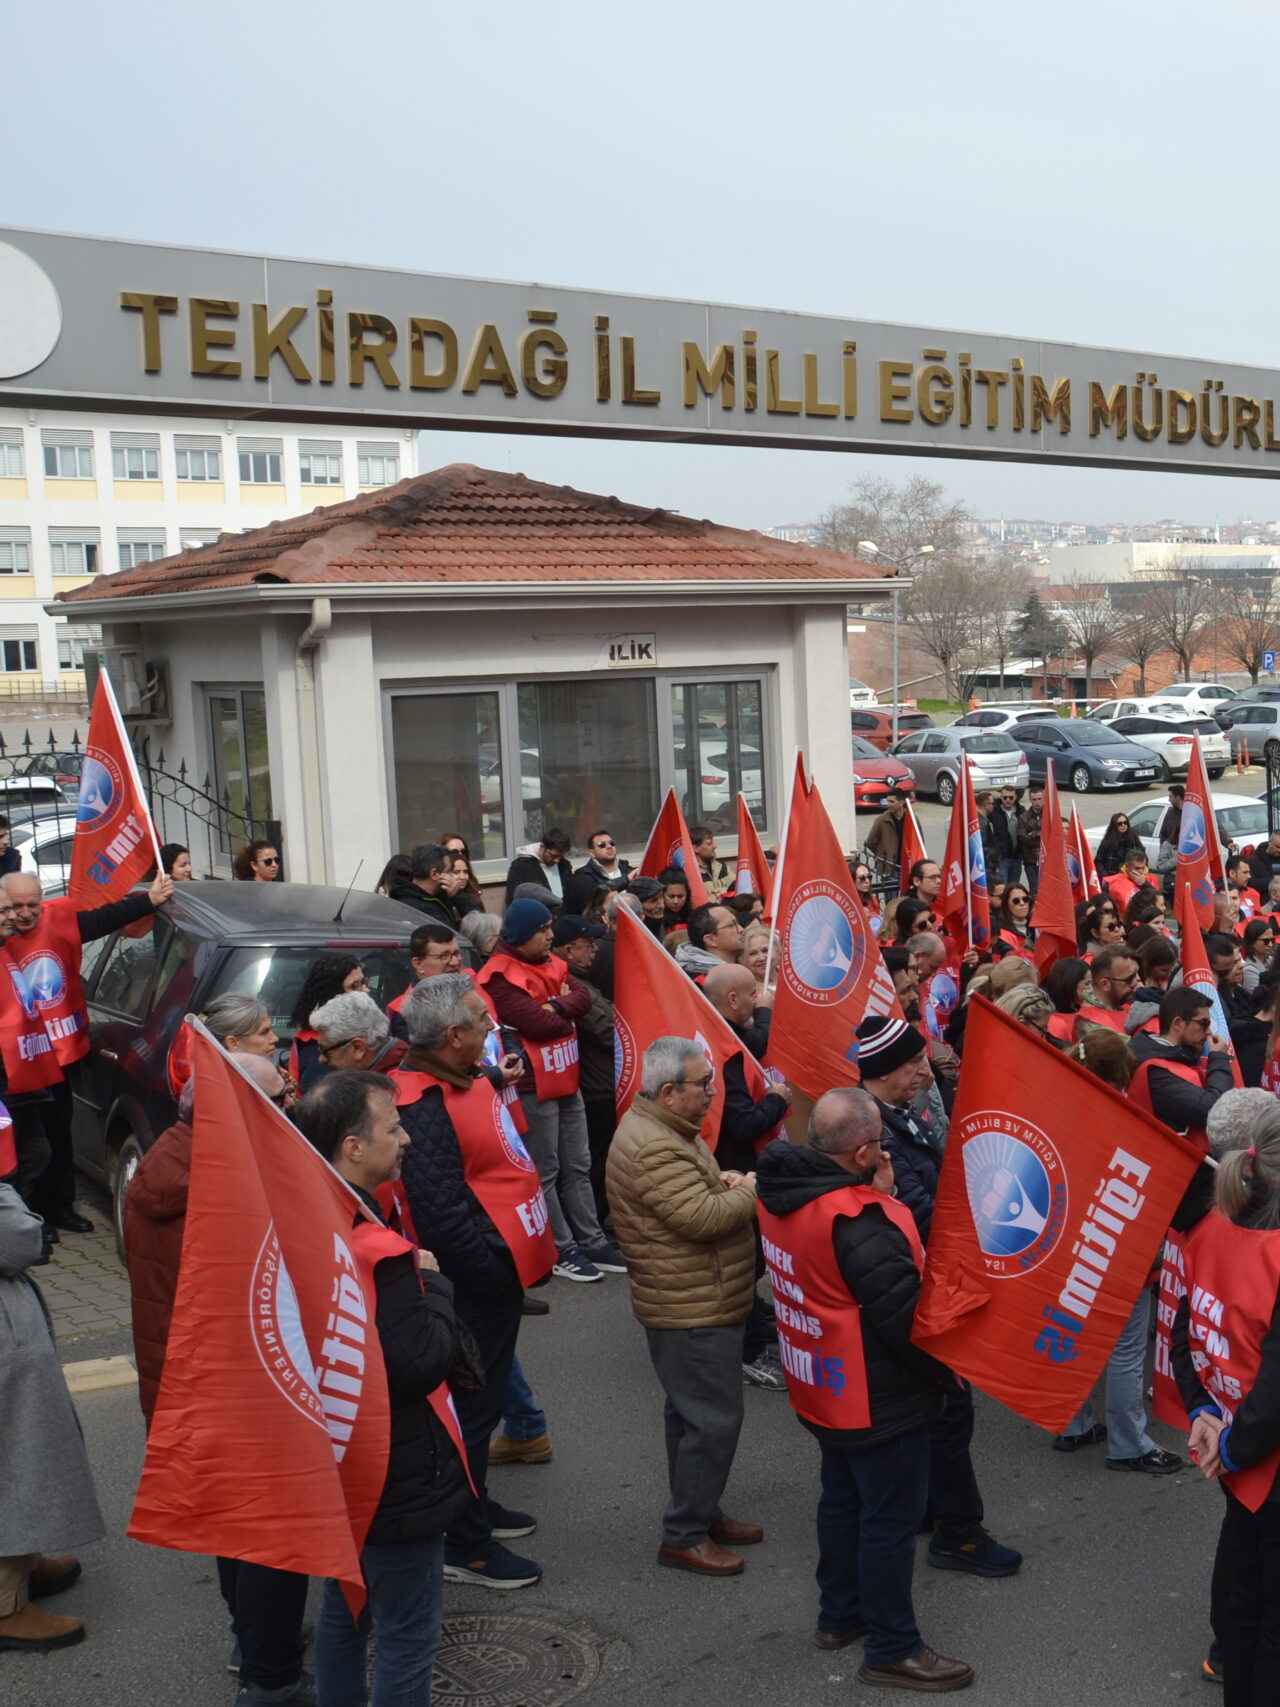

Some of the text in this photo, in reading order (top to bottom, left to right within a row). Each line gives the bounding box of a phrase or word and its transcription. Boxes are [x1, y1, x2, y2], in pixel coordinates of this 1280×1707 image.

[120, 288, 568, 398] TEKİRDAĞ
[594, 315, 661, 404] İL
[682, 329, 857, 418] MİLLİ
[878, 348, 1071, 434] EĞİTİM
[774, 1297, 824, 1340] RENİŞ
